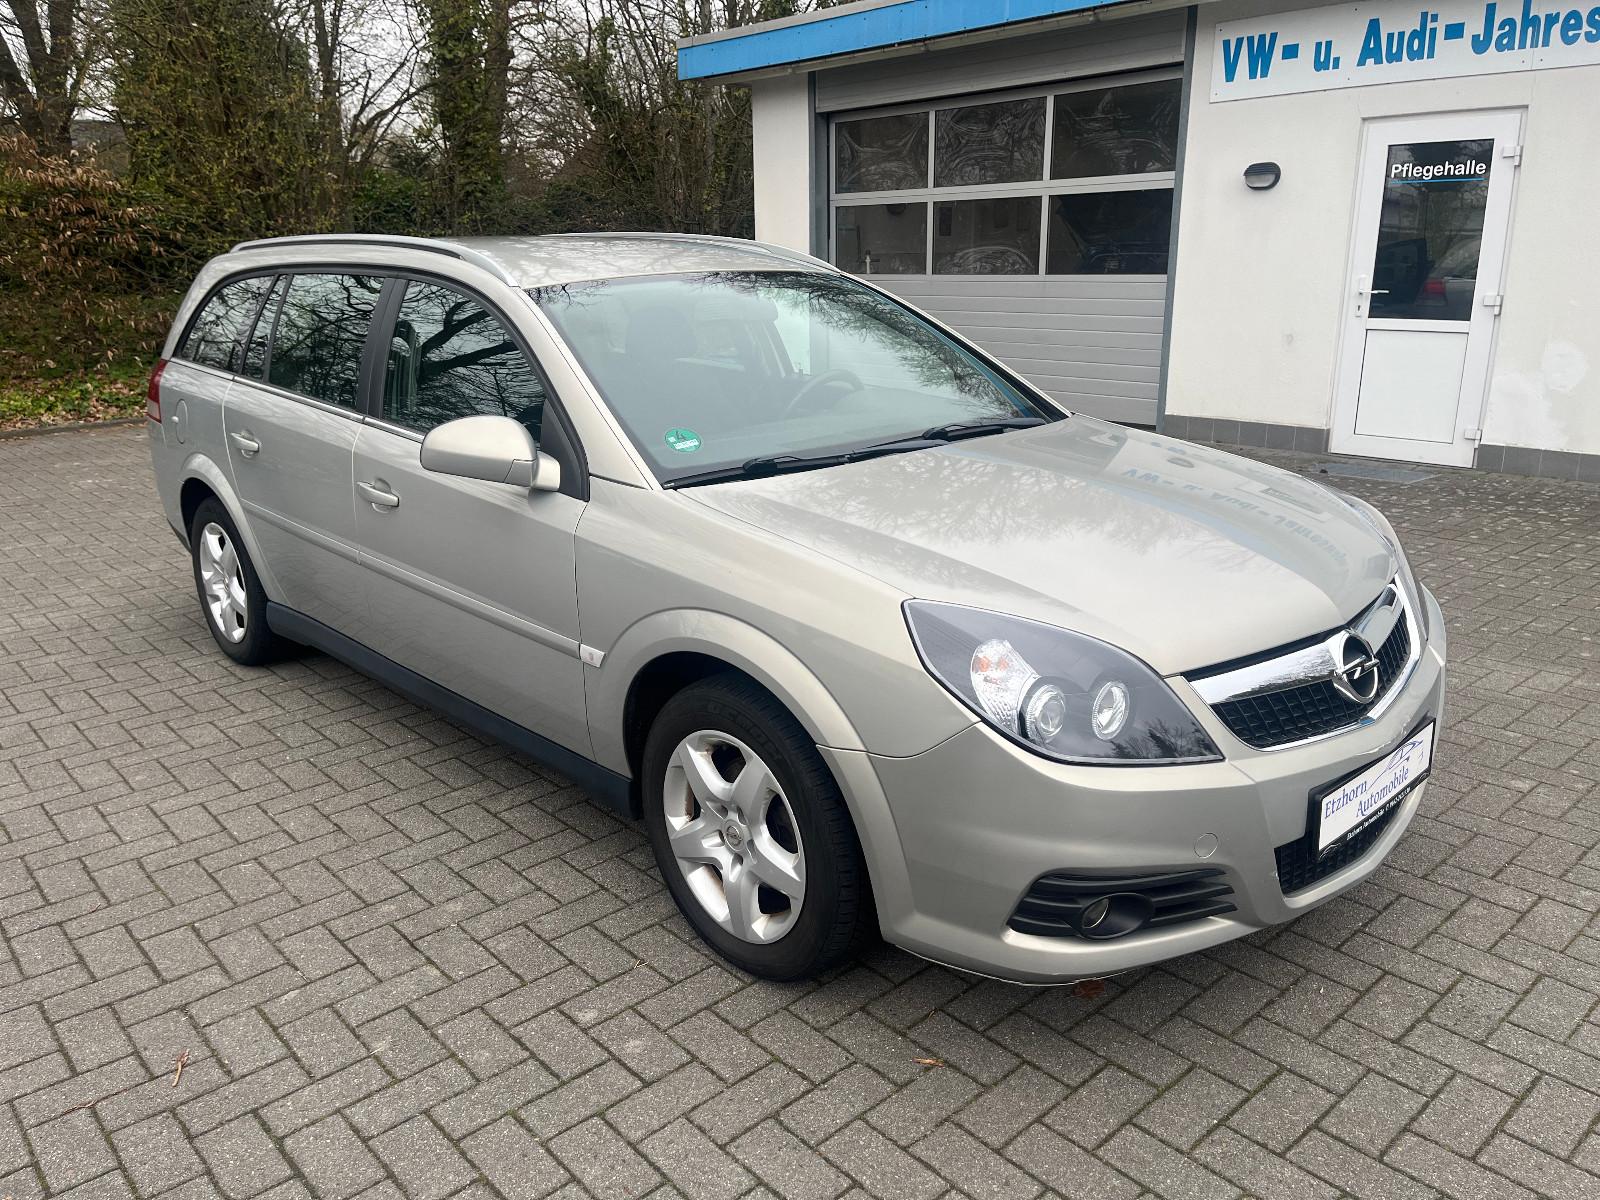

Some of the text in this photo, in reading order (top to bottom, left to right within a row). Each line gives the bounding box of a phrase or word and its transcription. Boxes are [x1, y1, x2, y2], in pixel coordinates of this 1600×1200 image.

[1222, 31, 1299, 83] VW-
[1313, 39, 1341, 73] u.
[1390, 159, 1487, 180] Pflegehalle
[1324, 780, 1368, 819] Etzhorn
[1355, 765, 1409, 818] Automobile
